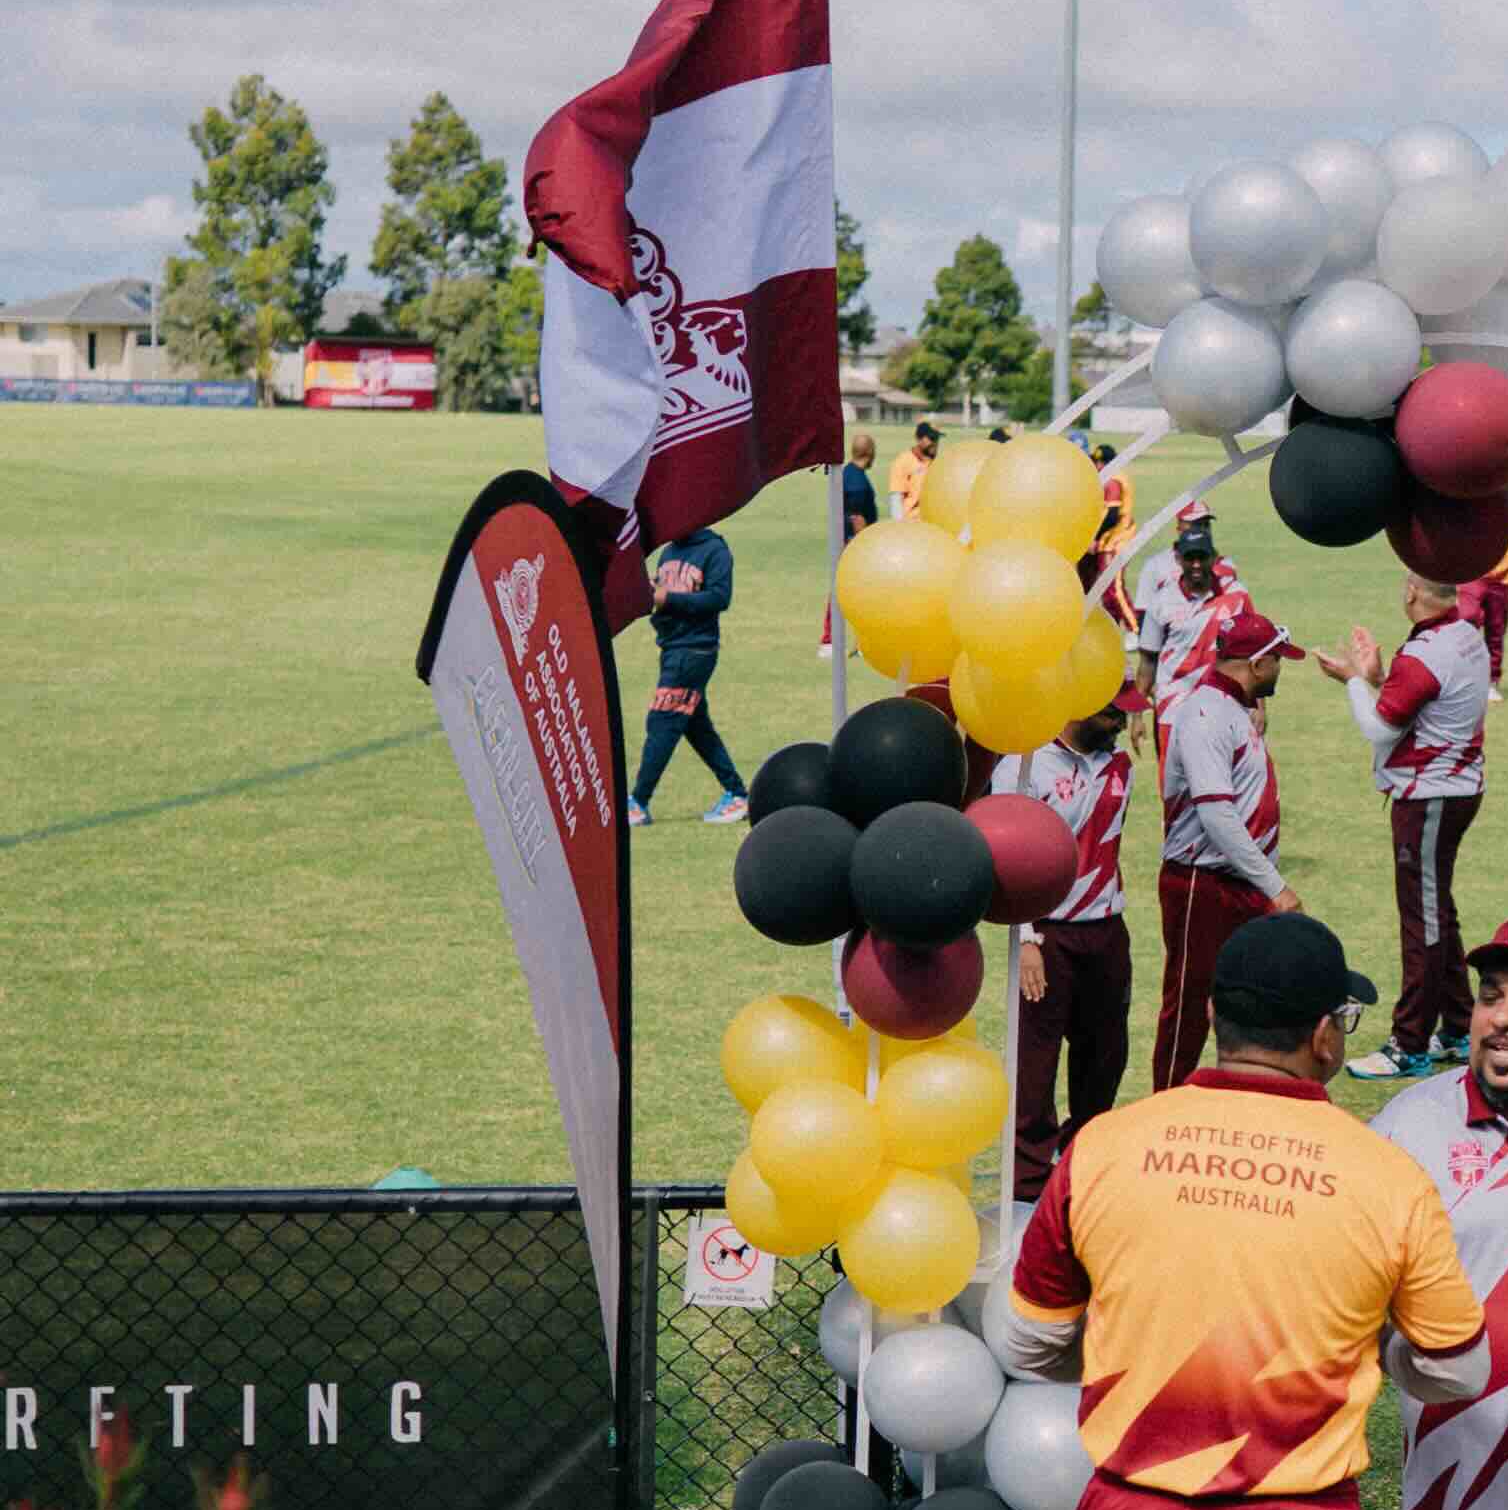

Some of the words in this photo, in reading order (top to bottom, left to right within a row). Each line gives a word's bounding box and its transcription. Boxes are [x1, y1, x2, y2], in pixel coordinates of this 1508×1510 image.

[524, 672, 541, 703] OF
[534, 709, 578, 839] AUSTRALIA
[536, 651, 586, 801] ASSOCIATION
[548, 624, 568, 673] OLD
[565, 678, 611, 827] NALANDIANS
[1143, 1148, 1338, 1197] MAROONS
[1165, 1125, 1244, 1147] BATTLE
[1250, 1134, 1280, 1151] OF
[1285, 1138, 1326, 1161] THE
[1176, 1184, 1296, 1220] AUSTRALIA
